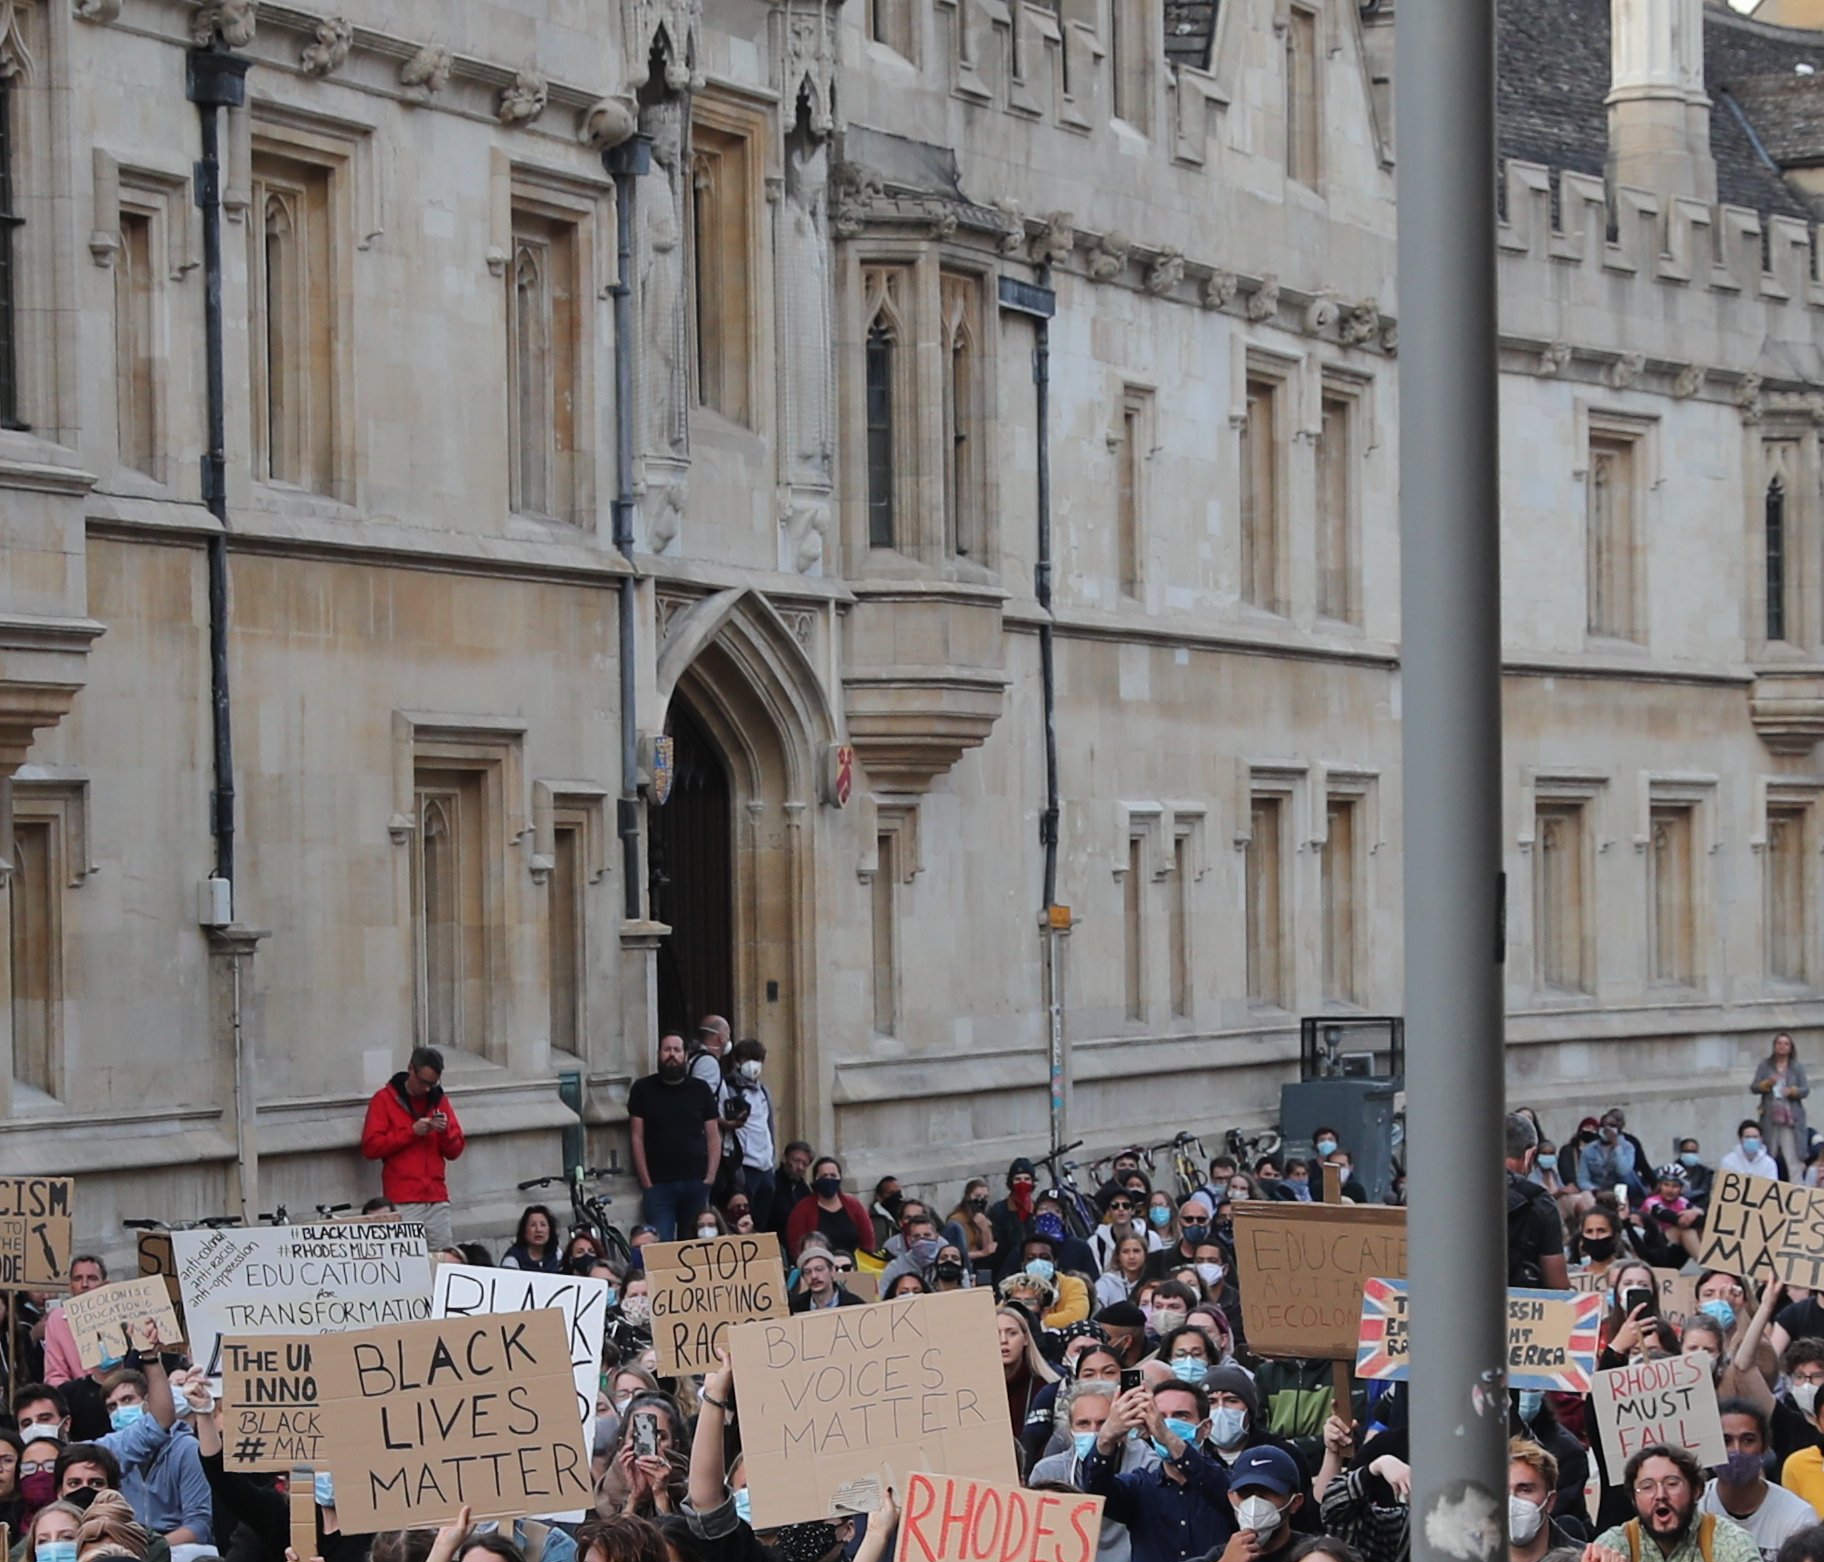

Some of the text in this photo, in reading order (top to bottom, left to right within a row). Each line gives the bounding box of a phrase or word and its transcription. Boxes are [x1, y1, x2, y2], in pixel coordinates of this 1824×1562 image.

[4, 1221, 22, 1235] TO
[350, 1243, 425, 1258] MUST FALL
[676, 1240, 758, 1284] STOP
[1252, 1229, 1407, 1275] EDUCATE
[245, 1261, 402, 1287] EDUCATION
[70, 1286, 151, 1316] DECOLONISE
[225, 1296, 434, 1327] TRANSFORMATION
[652, 1282, 773, 1317] GLORIFYING
[765, 1300, 923, 1369] BLACK
[224, 1345, 278, 1372] THE
[354, 1323, 537, 1397] BLACK
[781, 1348, 945, 1411] VOICES
[1609, 1358, 1703, 1401] RHODES
[238, 1411, 321, 1435] BLACK
[381, 1386, 539, 1450] LIVES
[783, 1389, 986, 1460] MATTER
[1616, 1387, 1695, 1425] MUST
[1617, 1420, 1701, 1458] FALL
[369, 1443, 588, 1510] MATTER
